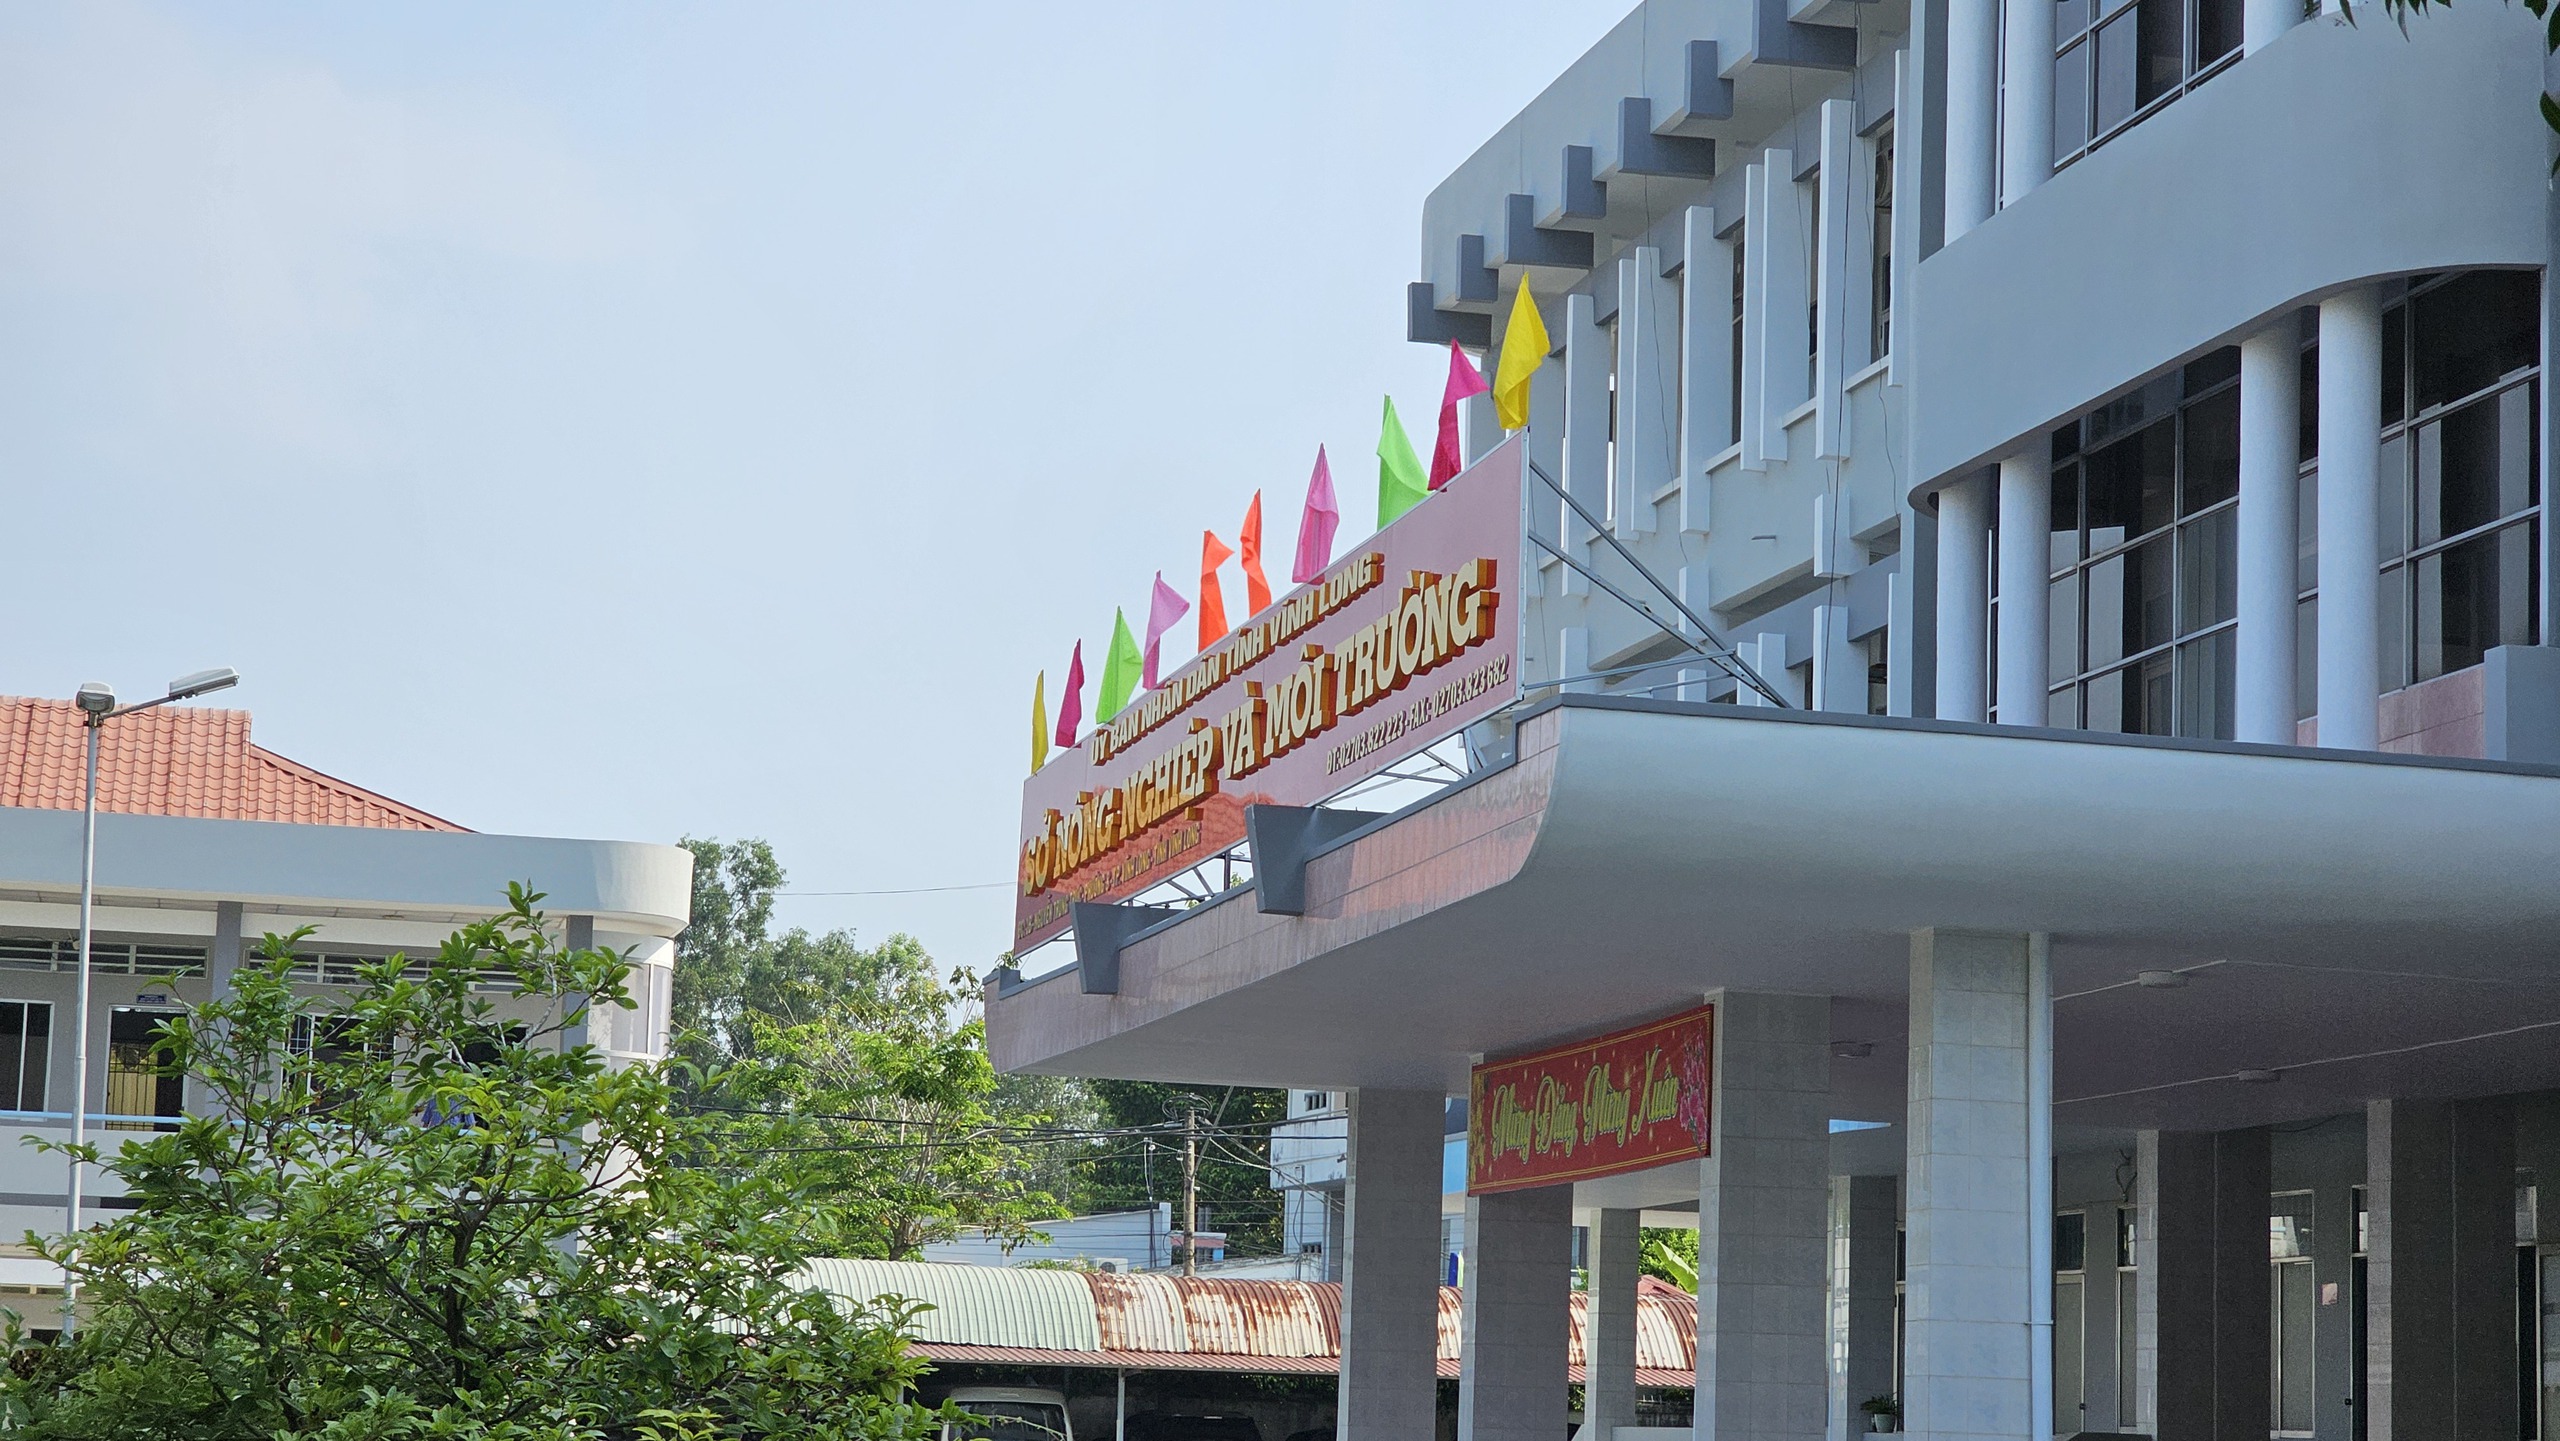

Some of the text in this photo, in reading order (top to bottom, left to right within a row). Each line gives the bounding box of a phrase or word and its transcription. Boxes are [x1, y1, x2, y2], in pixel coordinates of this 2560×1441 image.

[1023, 557, 1484, 895] SỞ NÔNG NGHIỆP VÀ MÔI TRƯỜNG
[1109, 707, 1141, 752] BAN
[1141, 681, 1184, 730] NHÂN
[1185, 655, 1222, 701] DÂN
[1224, 629, 1265, 676] TỈNH
[1268, 600, 1314, 646] VĨNH
[1318, 552, 1376, 614] LONG
[1487, 652, 1509, 690] 682
[1491, 1083, 1535, 1165] Mừng
[1583, 1063, 1632, 1149] Mừng
[1632, 1044, 1680, 1137] Xuân
